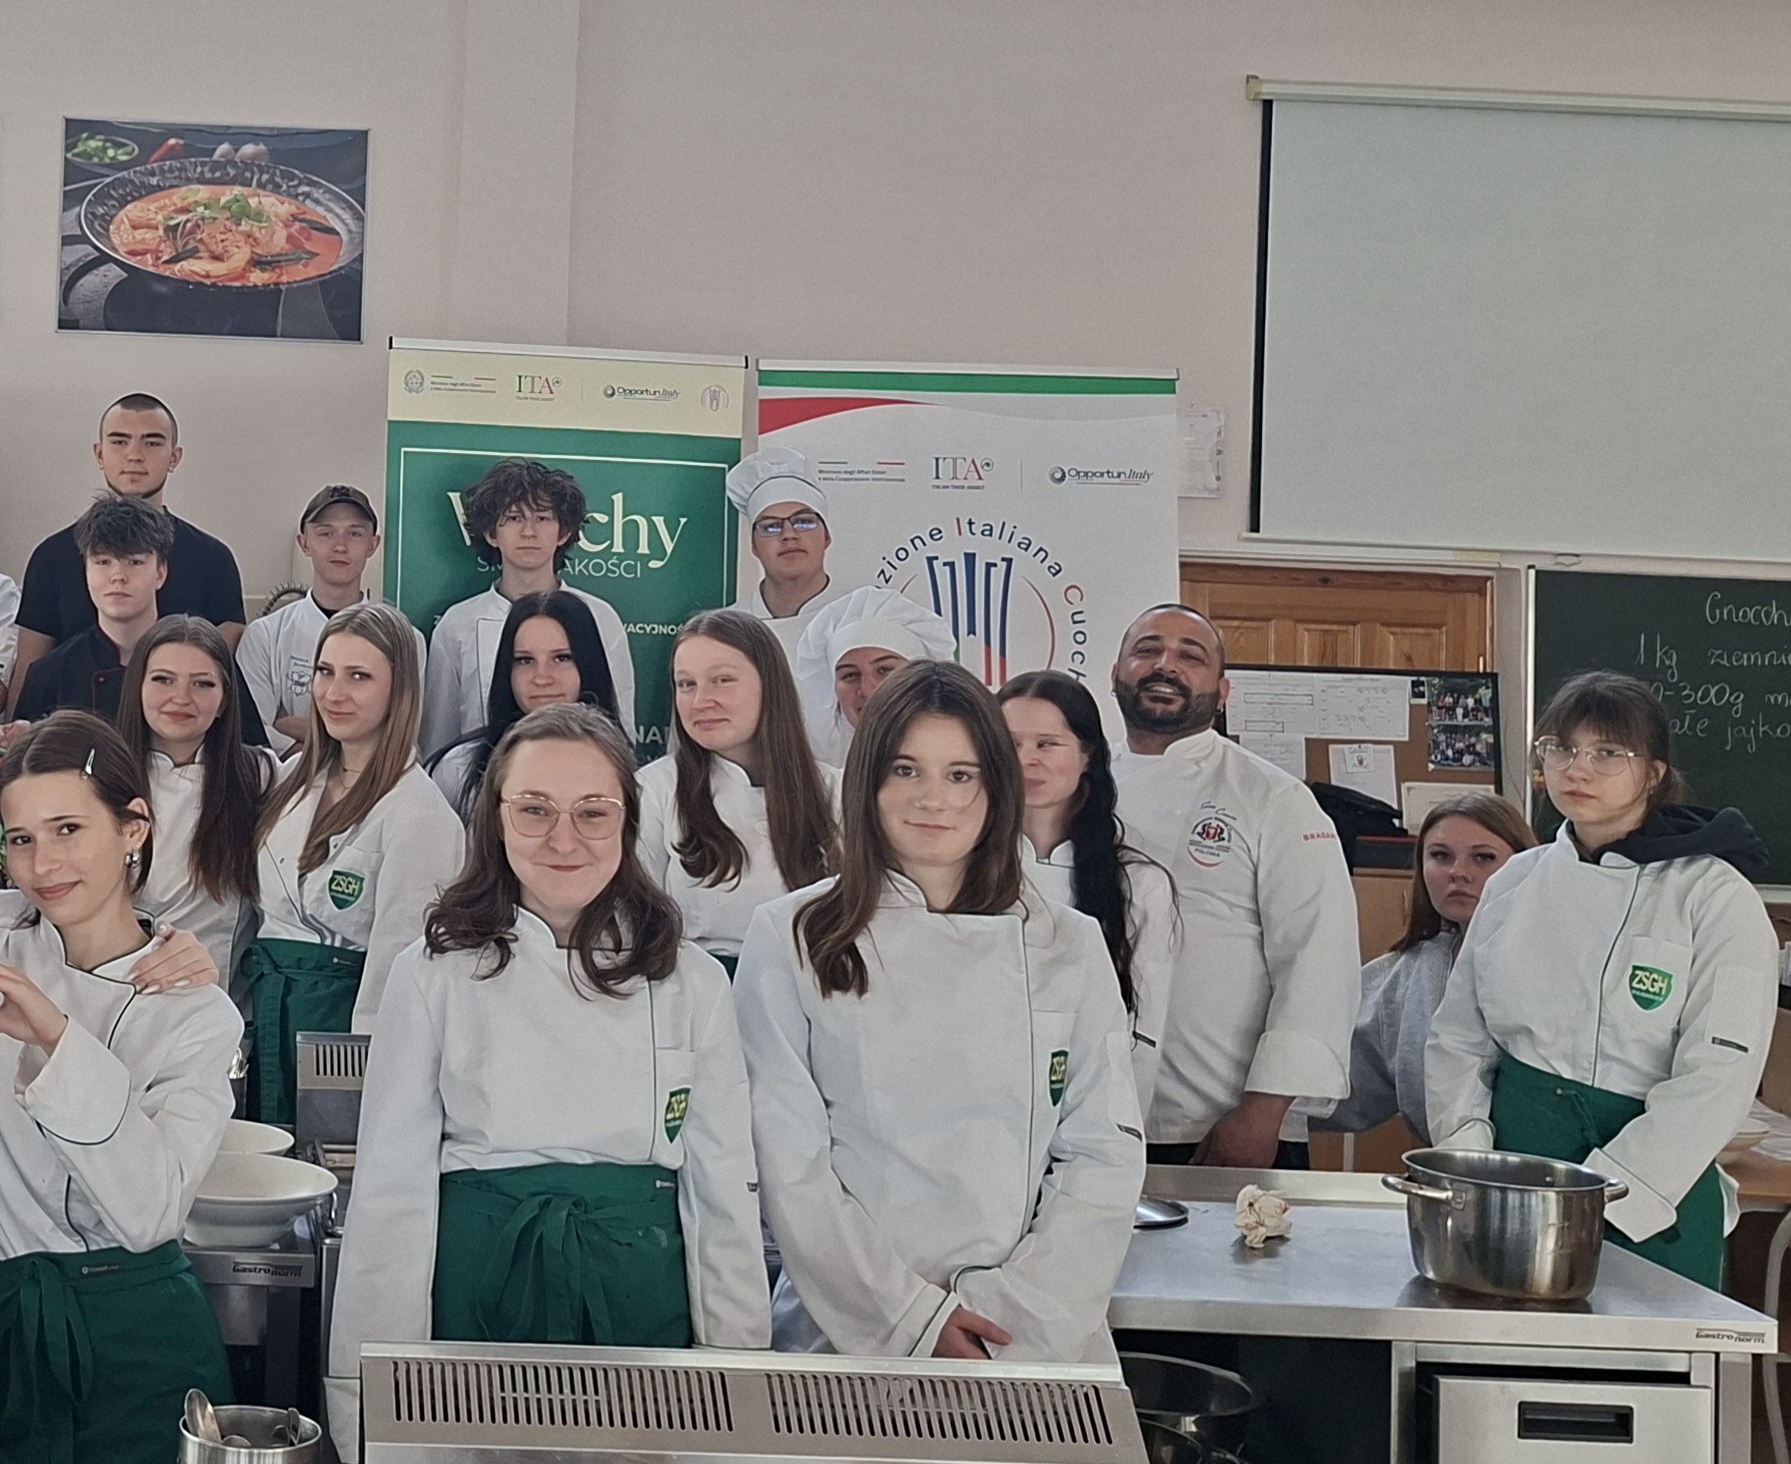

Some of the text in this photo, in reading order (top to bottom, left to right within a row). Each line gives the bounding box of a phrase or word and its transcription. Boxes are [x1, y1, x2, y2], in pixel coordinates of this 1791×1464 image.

[516, 375, 554, 394] ITA
[932, 456, 984, 480] ITA
[564, 556, 641, 578] AKOŚCI
[876, 517, 1087, 683] zione Italiana Cuoch
[1706, 591, 1791, 626] Gnocch
[624, 622, 683, 635] ACYJNO
[1656, 632, 1678, 682] kg
[1708, 645, 1791, 666] ziemni
[331, 874, 361, 896] ZSGH
[1632, 970, 1668, 995] ZSGH
